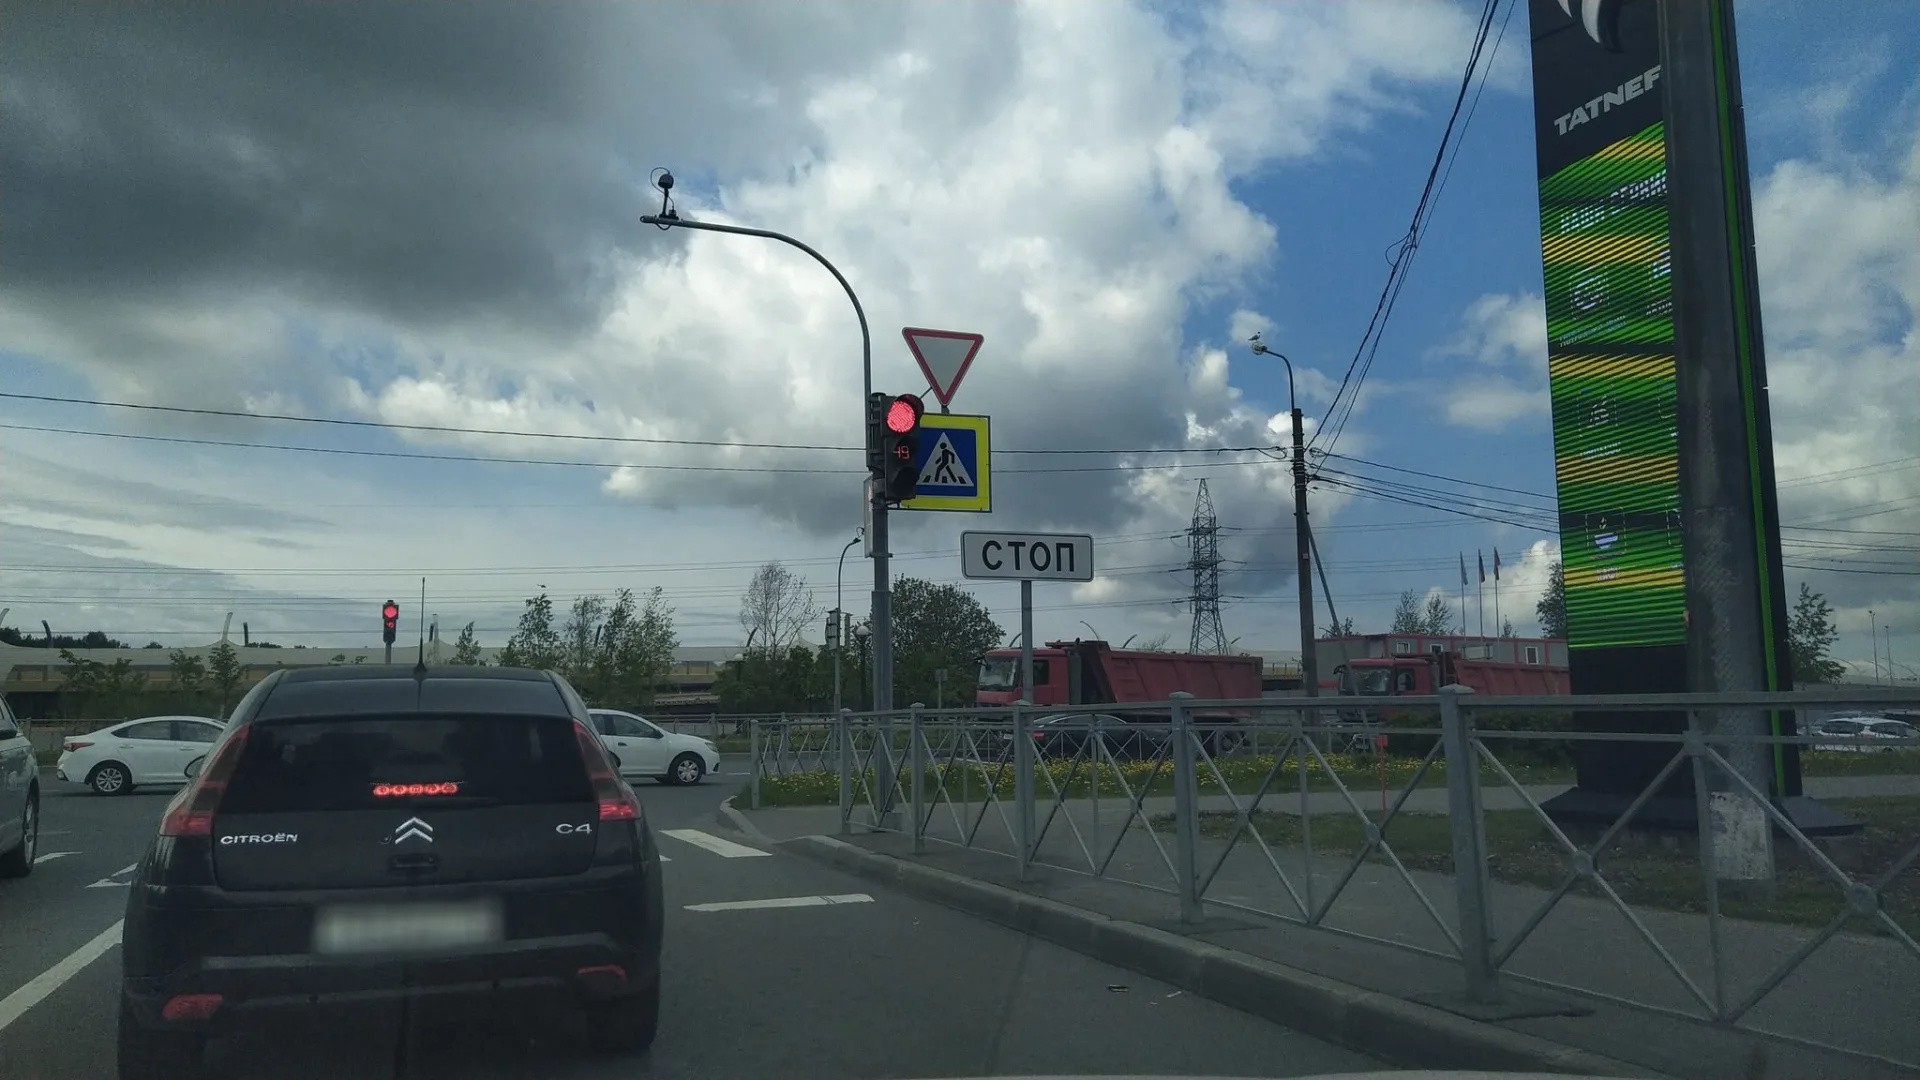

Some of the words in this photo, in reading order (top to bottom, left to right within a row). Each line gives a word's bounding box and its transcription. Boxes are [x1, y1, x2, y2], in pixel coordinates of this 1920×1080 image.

[982, 540, 1074, 572] СТОП
[555, 823, 593, 835] C4
[220, 832, 298, 845] CITROËN
